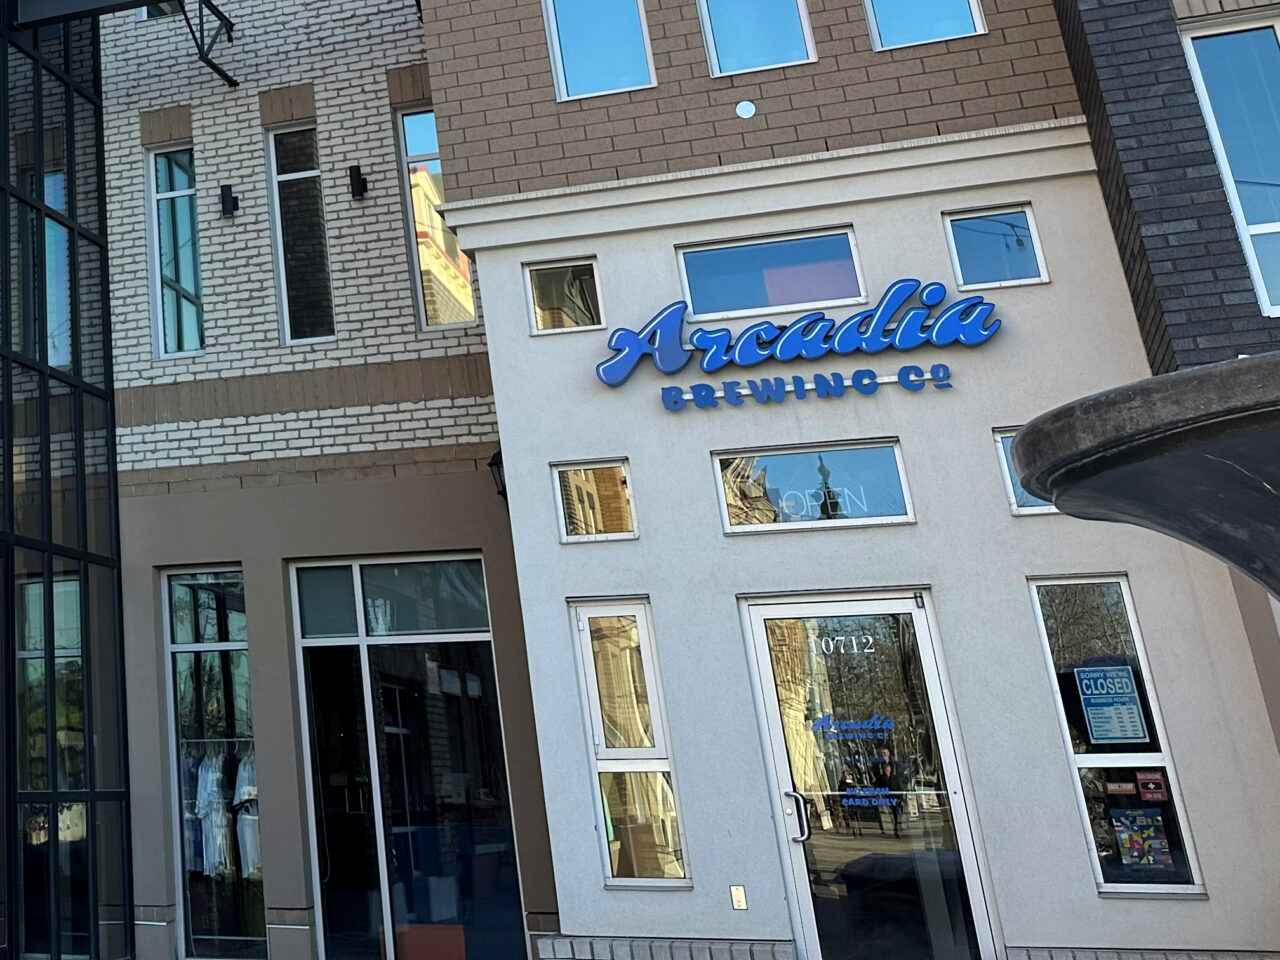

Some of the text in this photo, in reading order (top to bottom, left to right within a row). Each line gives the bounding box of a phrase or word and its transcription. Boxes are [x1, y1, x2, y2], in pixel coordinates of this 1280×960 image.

[596, 278, 1002, 388] Arcadia
[661, 371, 879, 412] BREWING
[782, 486, 868, 517] OPEN
[1081, 678, 1132, 695] CLOSED
[841, 797, 898, 807] CARD ONLY
